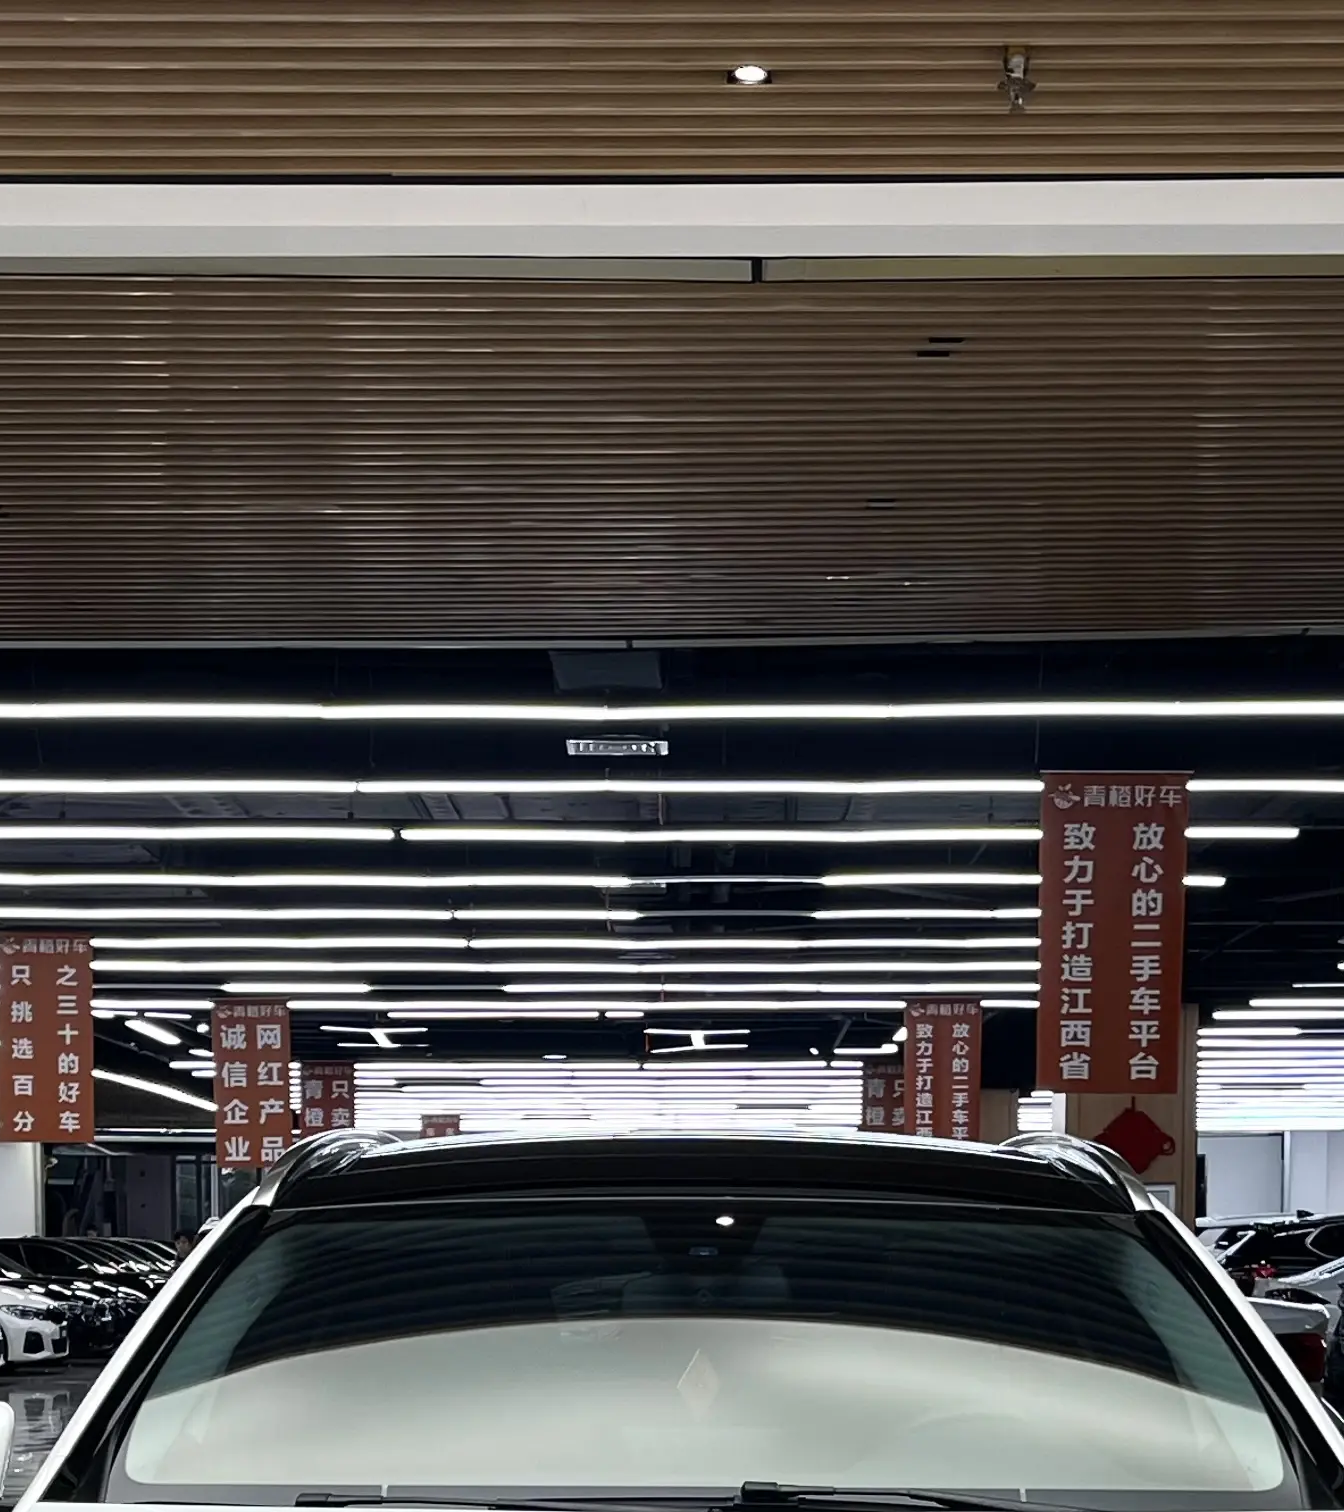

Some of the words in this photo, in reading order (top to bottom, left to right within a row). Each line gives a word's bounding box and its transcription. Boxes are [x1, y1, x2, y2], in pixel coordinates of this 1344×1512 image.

[1083, 785, 1183, 808] 青橙好车
[1059, 823, 1097, 1081] 致力于打造江西省
[1128, 823, 1166, 1081] 放心的二手车平台
[10, 965, 36, 1133] 只挑选百分
[56, 964, 81, 1133] 之三十的好车
[220, 1023, 252, 1162] 诚信企业
[256, 1024, 286, 1162] 网红产品
